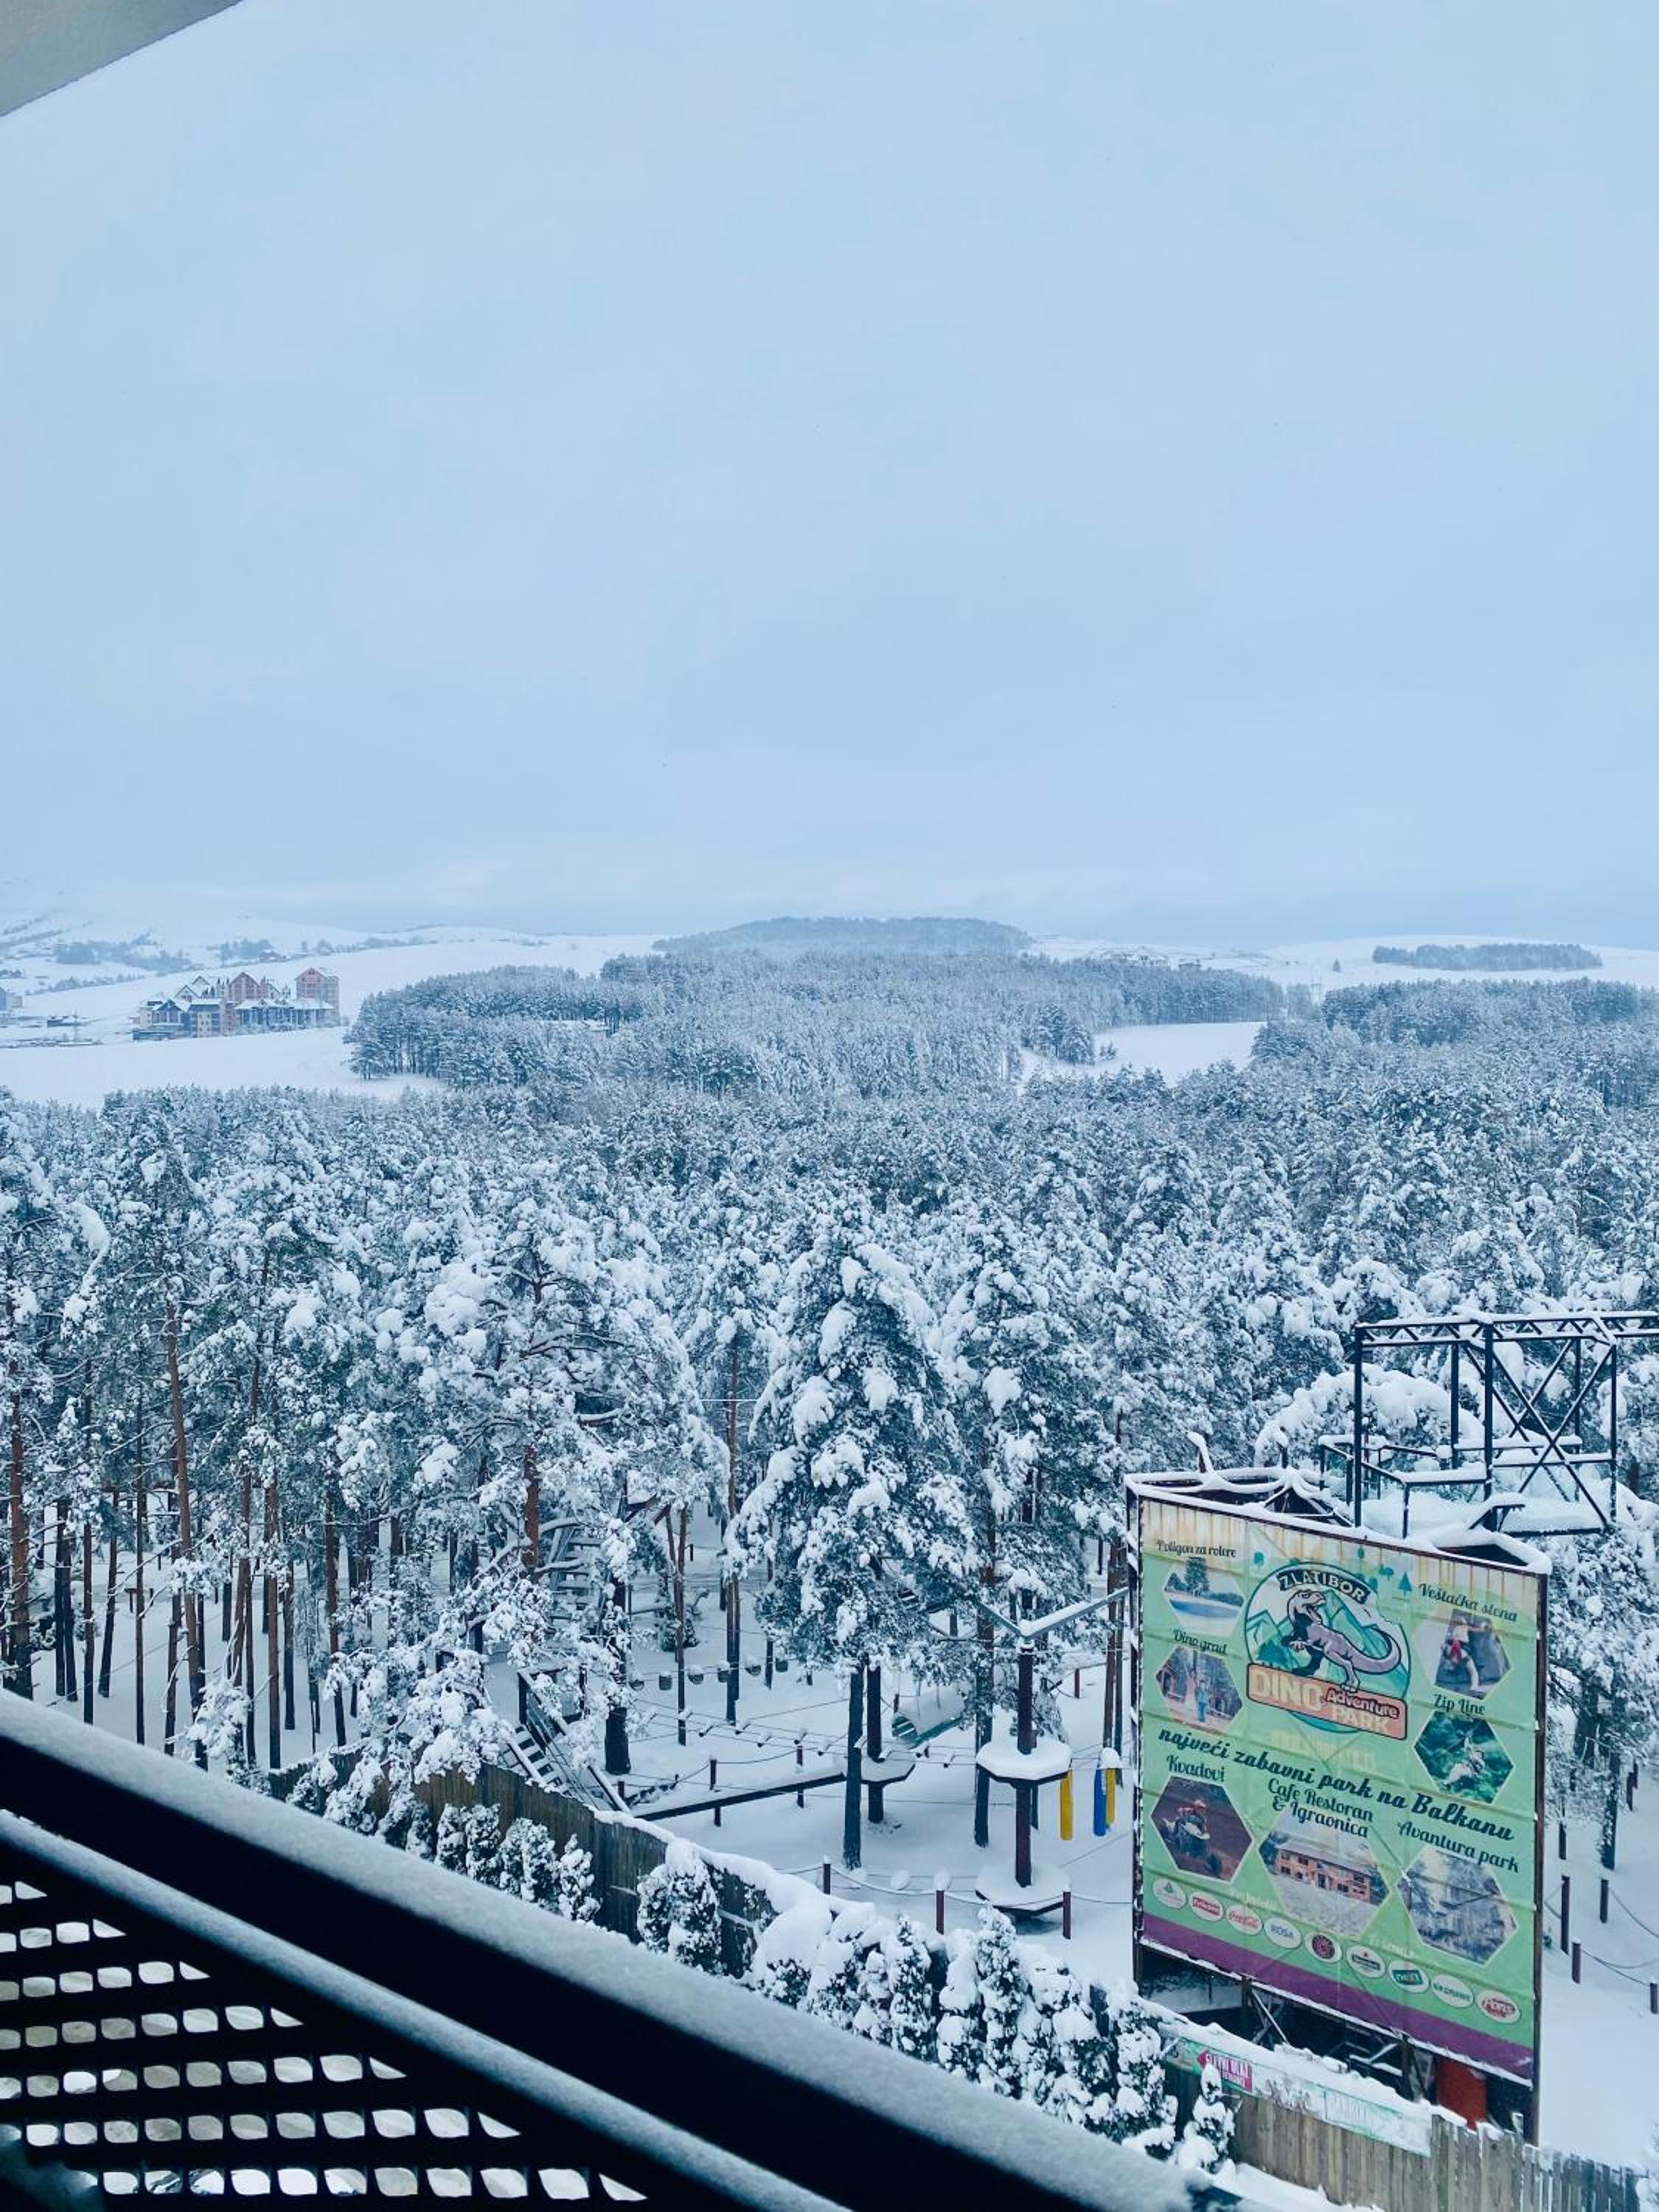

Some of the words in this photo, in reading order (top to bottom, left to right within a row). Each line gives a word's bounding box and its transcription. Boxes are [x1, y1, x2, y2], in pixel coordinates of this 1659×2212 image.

[1194, 1545, 1207, 1556] za
[1279, 1570, 1366, 1601] ZLATIBOR
[1481, 1603, 1518, 1622] stena
[1173, 1628, 1199, 1646] Dino
[1200, 1641, 1228, 1655] grad
[1251, 1669, 1323, 1712] DINO
[1326, 1688, 1399, 1719] Adventure
[1433, 1693, 1455, 1713] Zip
[1458, 1698, 1486, 1717] Line
[1332, 1705, 1389, 1733] PARK
[1166, 1754, 1225, 1782] Kvadovi
[1158, 1728, 1231, 1759] najveći
[1233, 1750, 1317, 1785] zabavni
[1318, 1771, 1374, 1799] park
[1377, 1789, 1408, 1809] na
[1411, 1792, 1514, 1841] Balkanu
[1267, 1777, 1301, 1803] Cafe
[1304, 1789, 1374, 1823] Restoran
[1272, 1795, 1285, 1812] &
[1289, 1801, 1368, 1838] Igraonica
[1398, 1820, 1475, 1859] Avantura
[1478, 1851, 1519, 1874] park
